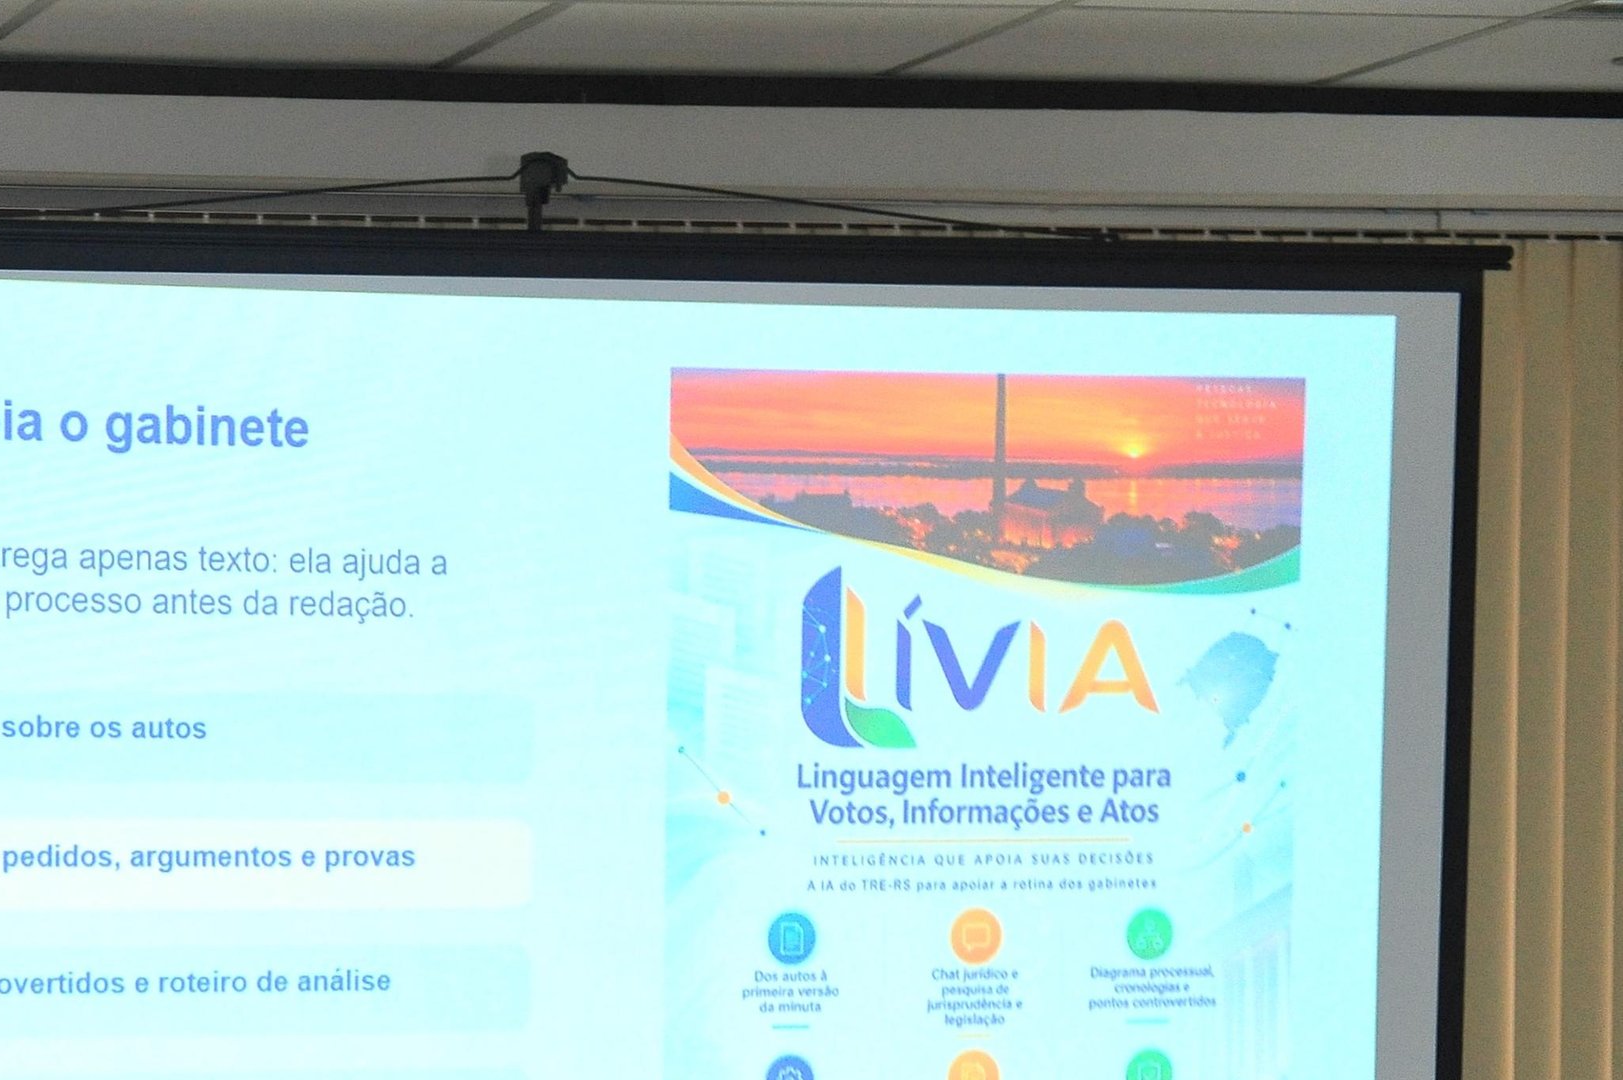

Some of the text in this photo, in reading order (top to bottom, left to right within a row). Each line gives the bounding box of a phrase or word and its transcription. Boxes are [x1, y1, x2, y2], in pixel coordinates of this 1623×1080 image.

[60, 411, 88, 442] o
[106, 405, 309, 453] gabinete
[79, 544, 188, 574] apenas
[198, 545, 278, 573] texto:
[289, 547, 332, 574] ela
[342, 548, 422, 581] ajuda
[430, 553, 448, 575] a
[6, 589, 141, 619] processo
[153, 589, 233, 616] antes
[243, 589, 279, 617] da
[289, 591, 413, 625] redação.
[800, 566, 1161, 749] LÍVIA
[2, 714, 81, 739] sobre
[89, 719, 122, 739] os
[131, 717, 207, 740] autos
[797, 763, 1172, 795] Linguagem Inteligente para
[810, 798, 1159, 830] Votos, Informações e Atos
[2, 844, 122, 873] pedidos,
[130, 847, 292, 873] argumentos
[301, 848, 316, 868] e
[324, 847, 416, 873] provas
[814, 851, 1154, 867] INTELIGÊNCIA QUE APOIA SUAS DECISÕES
[807, 878, 1157, 893] A IA do TRE-RS para apoiar a rotina dos gabinetes
[134, 975, 150, 994] e
[158, 969, 248, 994] roteiro
[257, 969, 289, 994] de
[297, 969, 391, 993] análise
